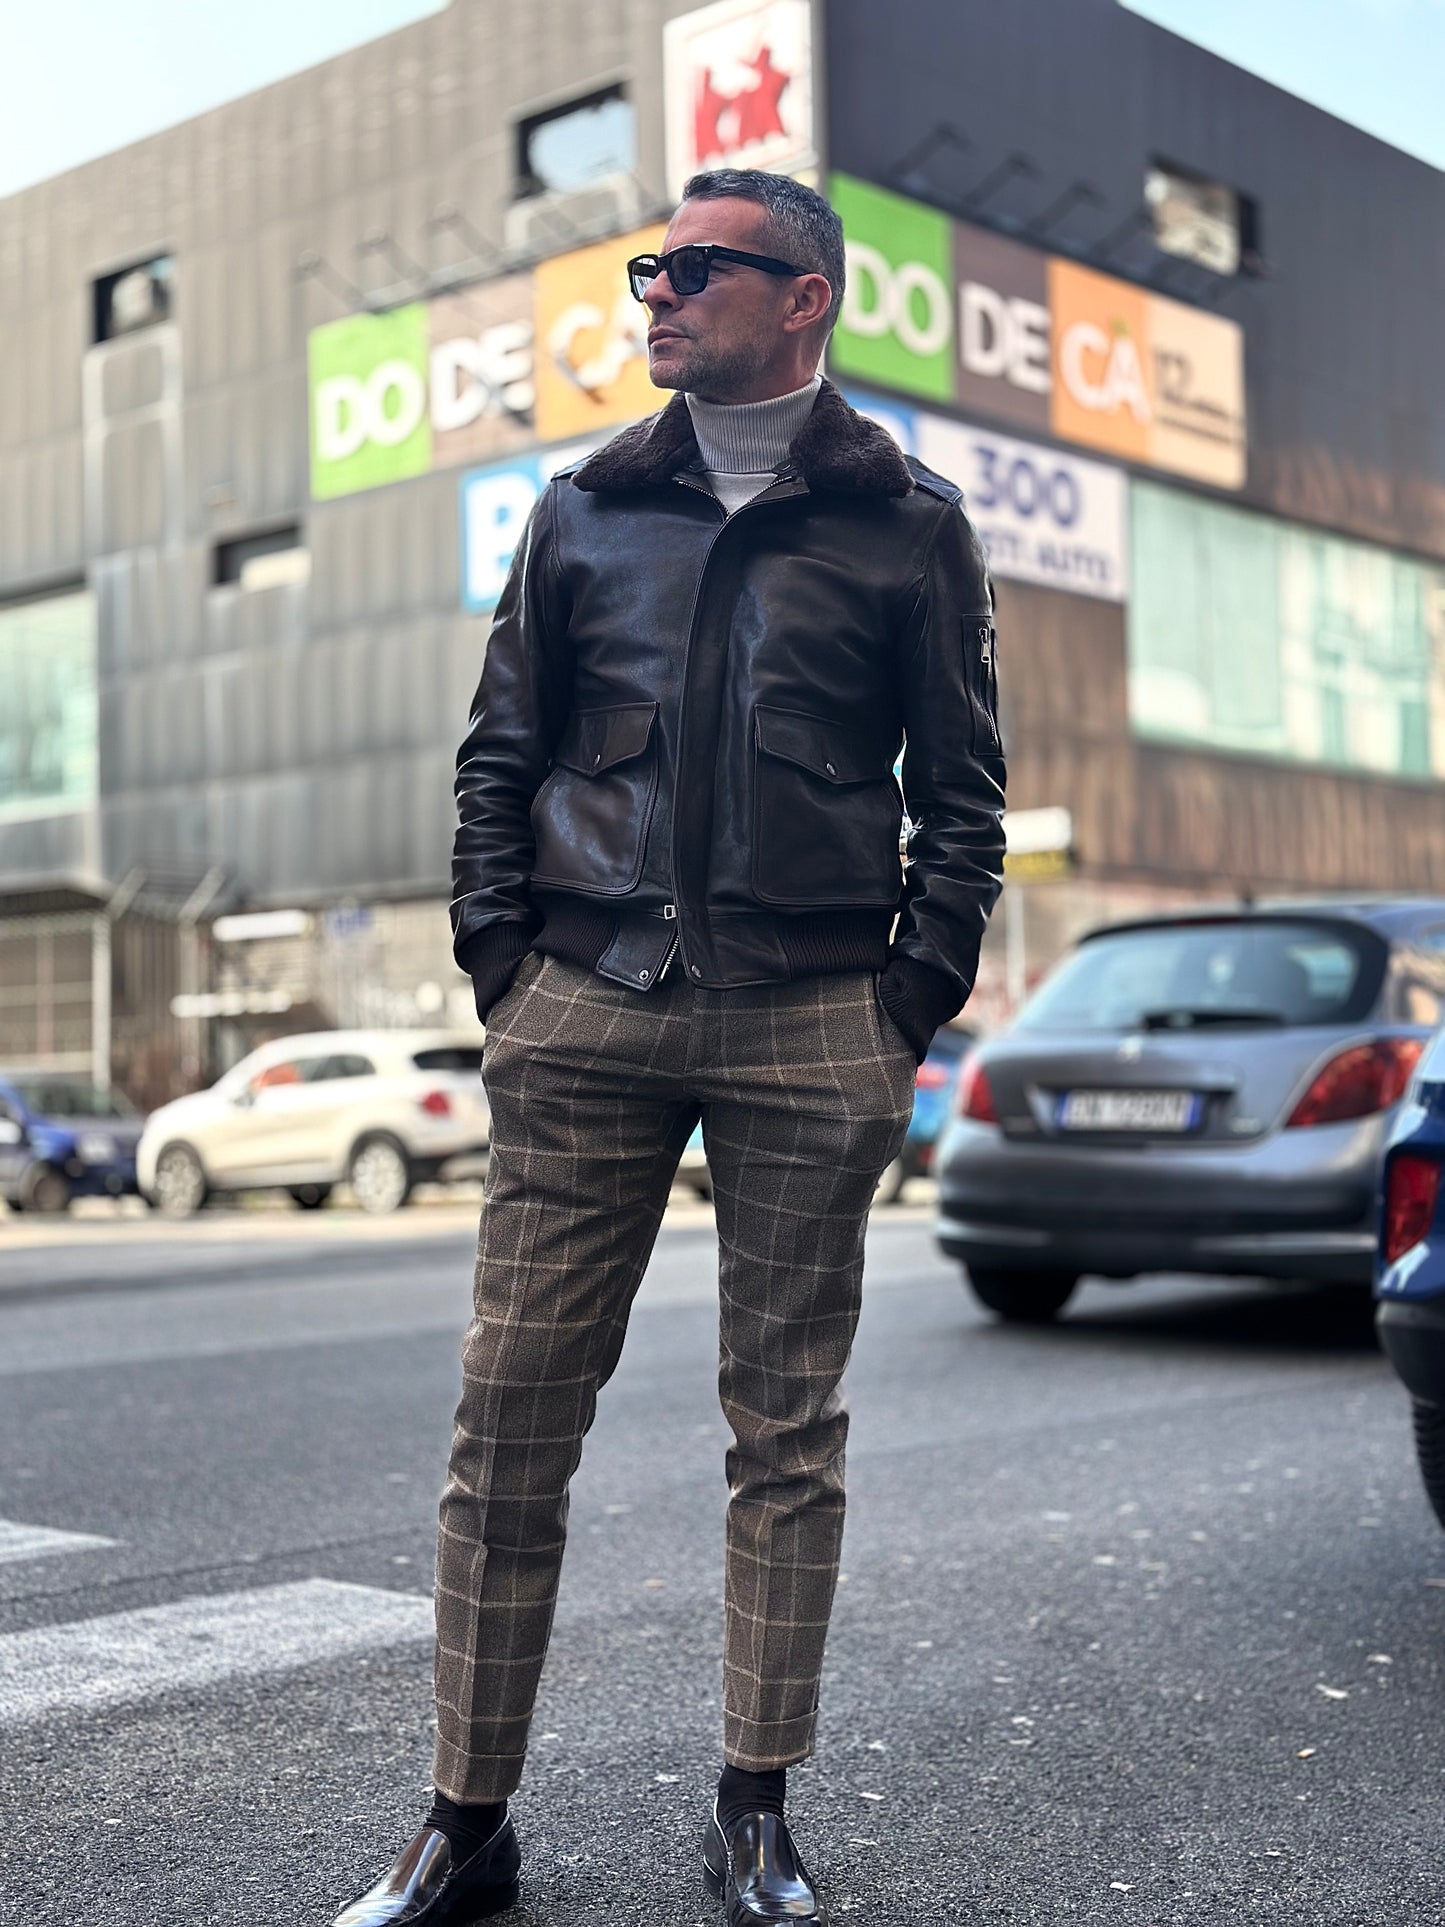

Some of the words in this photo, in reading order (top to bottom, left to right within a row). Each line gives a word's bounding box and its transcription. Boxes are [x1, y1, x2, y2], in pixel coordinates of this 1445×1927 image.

[842, 241, 953, 355] DO
[959, 281, 1051, 395] DE
[313, 360, 426, 461] DO
[974, 446, 1081, 528] 300
